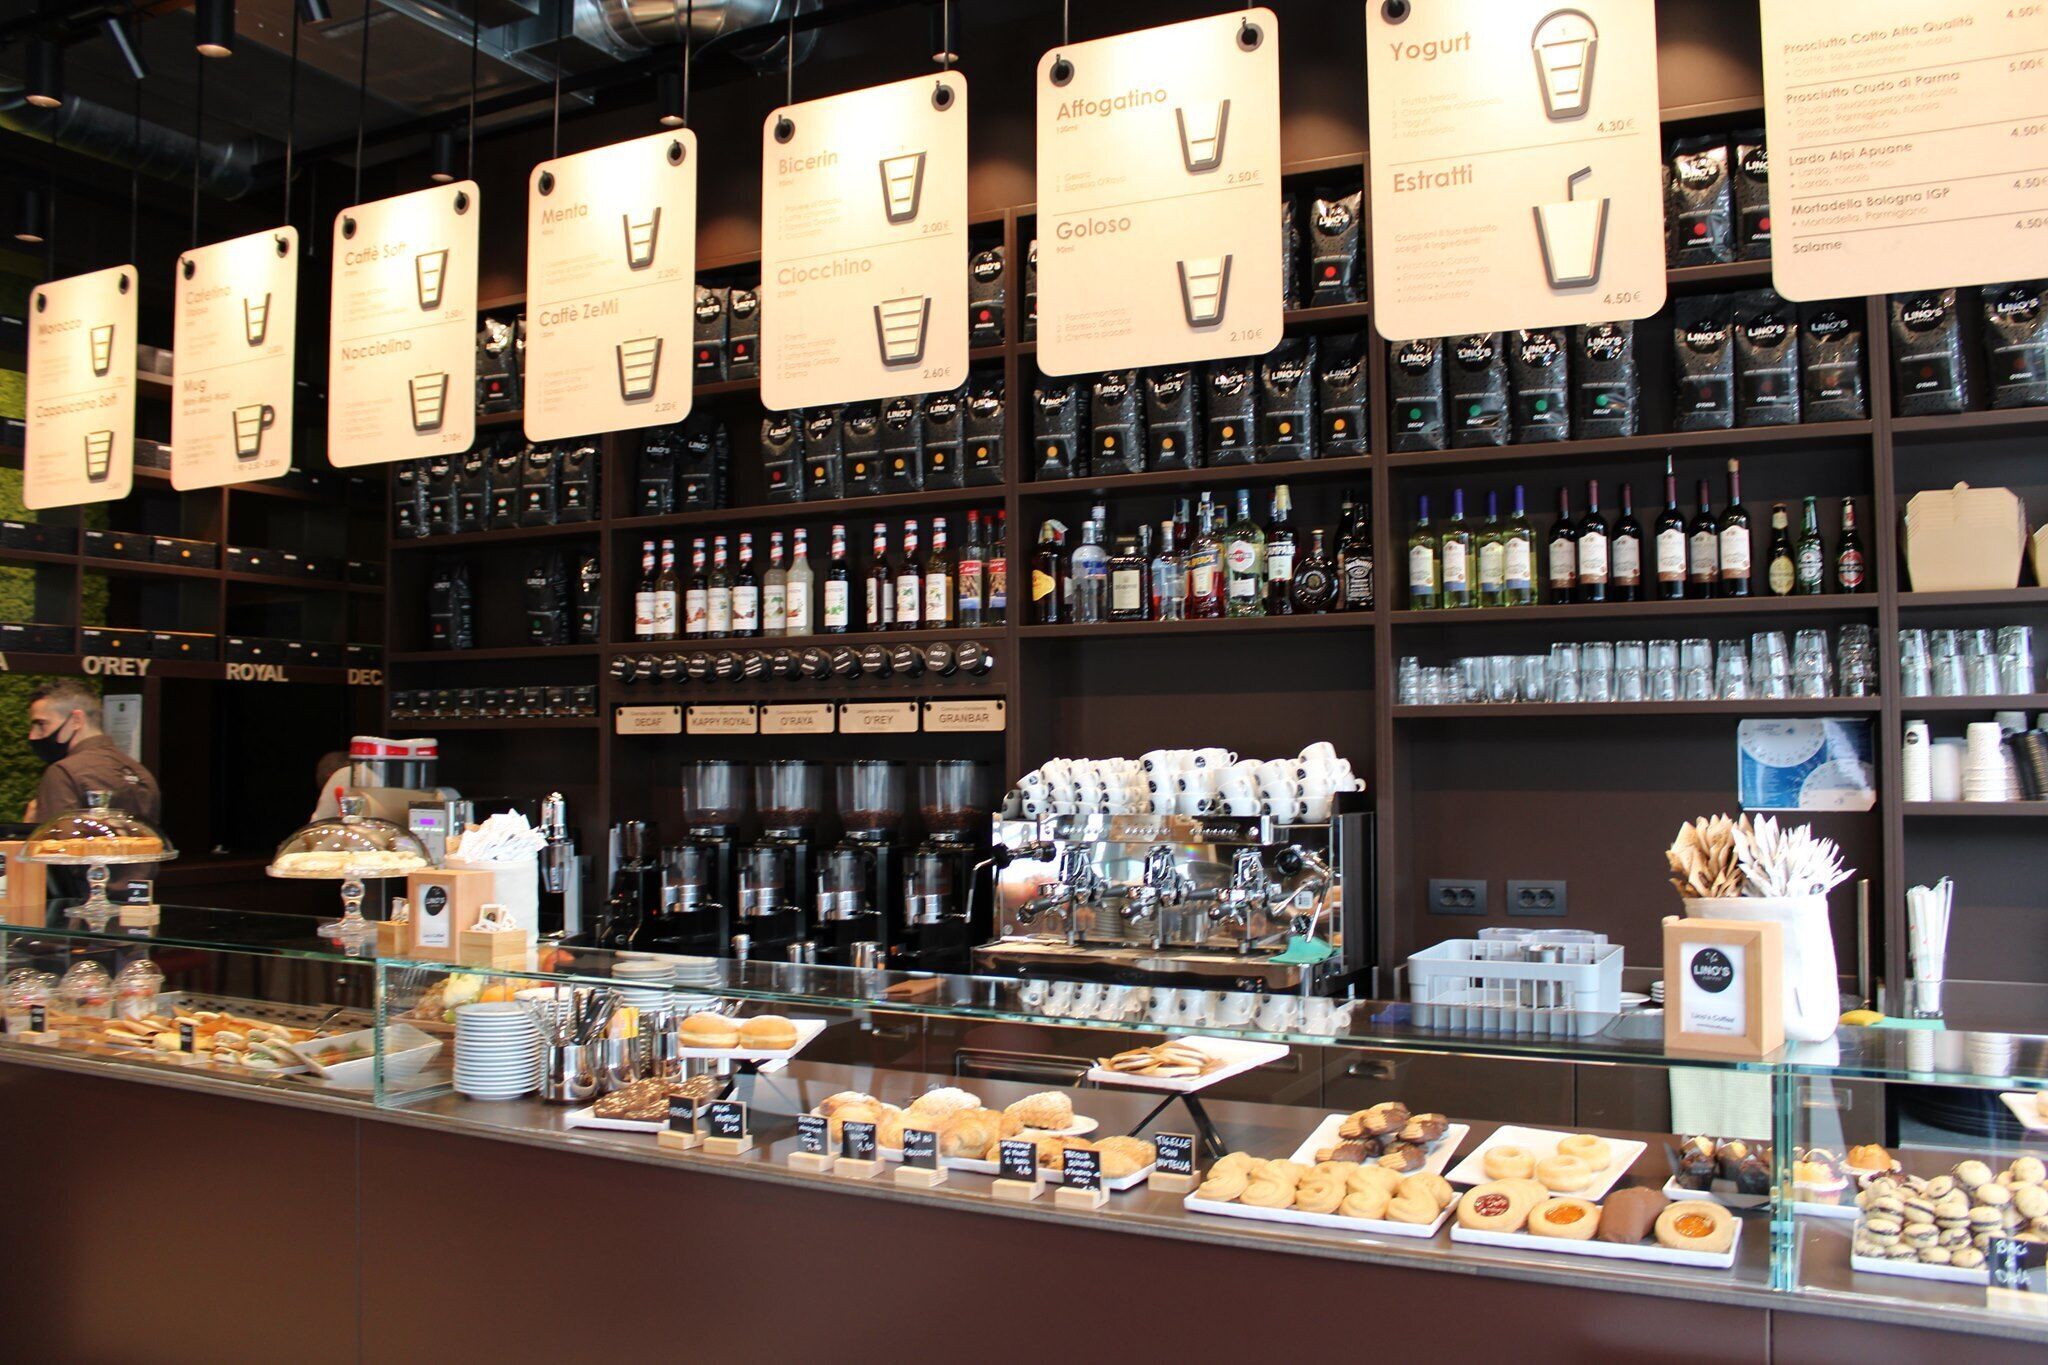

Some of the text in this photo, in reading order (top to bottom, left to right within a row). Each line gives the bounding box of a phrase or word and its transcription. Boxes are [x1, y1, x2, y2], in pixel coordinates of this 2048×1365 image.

[1784, 36, 1848, 54] Prosciutto
[1851, 30, 1888, 45] Cotto
[1892, 23, 1919, 38] Alta
[1390, 31, 1472, 62] Yogurt
[1785, 71, 1961, 105] Prosciutto Crudo di Parma
[1056, 87, 1168, 121] Affogatino
[1597, 118, 1634, 133] 4.30€
[1789, 142, 1914, 167] Lardo Alpi Apuane
[779, 150, 839, 176] Bicerin
[1227, 169, 1261, 184] 2.50€
[1393, 163, 1473, 193] Estratti
[1791, 186, 1951, 216] Mortadella Bologna IGP
[542, 203, 589, 225] Menta
[922, 220, 950, 234] 2.00€
[1056, 216, 1132, 240] Goloso
[1791, 240, 1844, 255] Salame
[344, 244, 380, 267] Caffè
[777, 257, 873, 286] Ciocchino
[1603, 291, 1640, 305] 4.50€
[1997, 298, 2040, 313] LINO'S
[539, 298, 620, 328] Caffè ZeMi
[1903, 306, 1944, 322] LINO'S
[1748, 324, 1785, 337] LINO'S
[1810, 319, 1849, 332] LINO'S
[1231, 328, 1264, 342] 2.10€
[1587, 337, 1622, 348] LINO'S
[1687, 331, 1723, 342] LINO'S
[341, 338, 413, 362] Nocciolino
[1458, 347, 1492, 359] LINO'S
[1400, 352, 1432, 364] LINO'S
[923, 367, 951, 380] 2.60€
[1271, 369, 1303, 381] LINO'S
[886, 408, 912, 419] LINO'S
[929, 403, 956, 414] LINO'S
[82, 656, 150, 677] O'REY
[226, 663, 289, 682] ROYAL
[863, 715, 895, 725] O'REY
[938, 713, 989, 723] GRANBAR
[1693, 964, 1731, 977] LINO'S
[1155, 1135, 1192, 1149] TIGELLE
[1159, 1146, 1179, 1158] CON
[1156, 1158, 1192, 1173] NUTELLA
